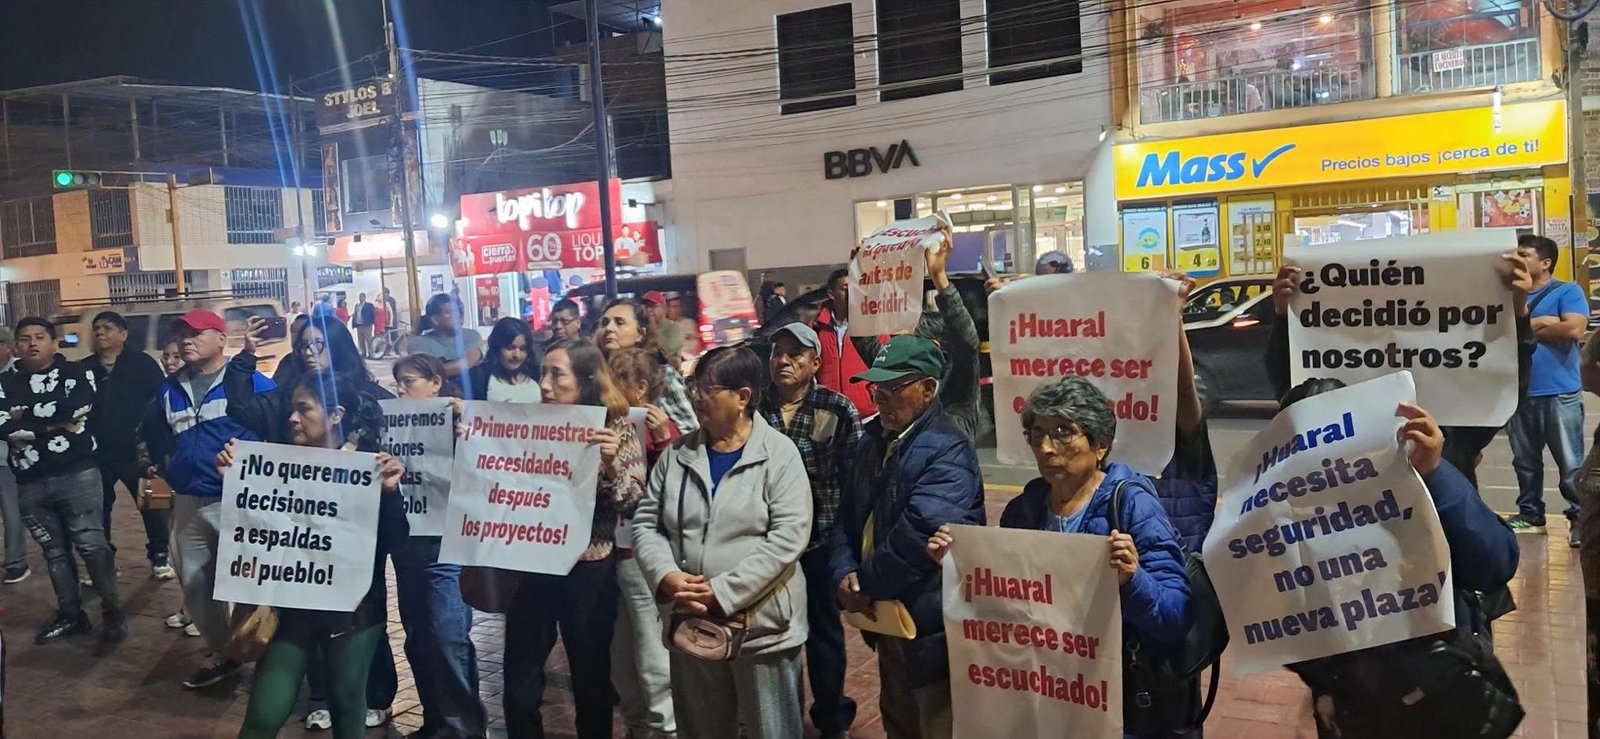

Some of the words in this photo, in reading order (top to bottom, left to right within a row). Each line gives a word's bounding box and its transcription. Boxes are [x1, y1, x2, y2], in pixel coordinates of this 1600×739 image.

[324, 85, 377, 106] STYLOS
[346, 100, 380, 118] JOEL
[824, 139, 921, 180] BBVA
[1136, 151, 1245, 188] Mass
[1321, 154, 1380, 171] Precios
[1386, 149, 1430, 168] bajos
[1437, 145, 1490, 163] ¡cerca
[1496, 142, 1517, 156] de
[1523, 139, 1539, 152] ti!
[496, 188, 586, 230] topitop
[527, 232, 562, 261] 60
[1193, 254, 1201, 267] 4
[859, 266, 894, 286] antes
[896, 261, 912, 281] de
[1141, 257, 1149, 269] 6
[1300, 259, 1424, 294] ¿Quién
[861, 291, 908, 315] decidir!
[1300, 299, 1431, 328] decidió
[1438, 304, 1503, 333] por
[1010, 311, 1105, 344] ¡Huaral
[1010, 357, 1105, 377] merece
[1110, 358, 1152, 379] ser
[1302, 341, 1486, 369] nosotros?
[464, 415, 528, 441] ¡Primero
[531, 422, 594, 443] nuestras
[1254, 412, 1355, 484] ¡Huaral
[239, 453, 274, 480] ¡No
[278, 459, 372, 486] queremos
[476, 451, 574, 480] necesidades,
[488, 483, 551, 511] después
[1240, 457, 1378, 515] necesita
[236, 488, 338, 517] decisiones
[234, 526, 245, 543] a
[248, 526, 332, 551] espaldas
[461, 514, 480, 537] los
[483, 519, 567, 546] proyectos!
[1228, 489, 1413, 559] seguridad,
[230, 555, 257, 578] del
[258, 559, 333, 585] pueblo!
[965, 567, 1053, 604] ¡Huaral
[1273, 565, 1314, 593] no
[1318, 547, 1387, 581] una
[963, 618, 1058, 650] merece
[1062, 630, 1099, 659] ser
[1244, 607, 1338, 644] nueva
[968, 663, 1108, 712] escuchado!
